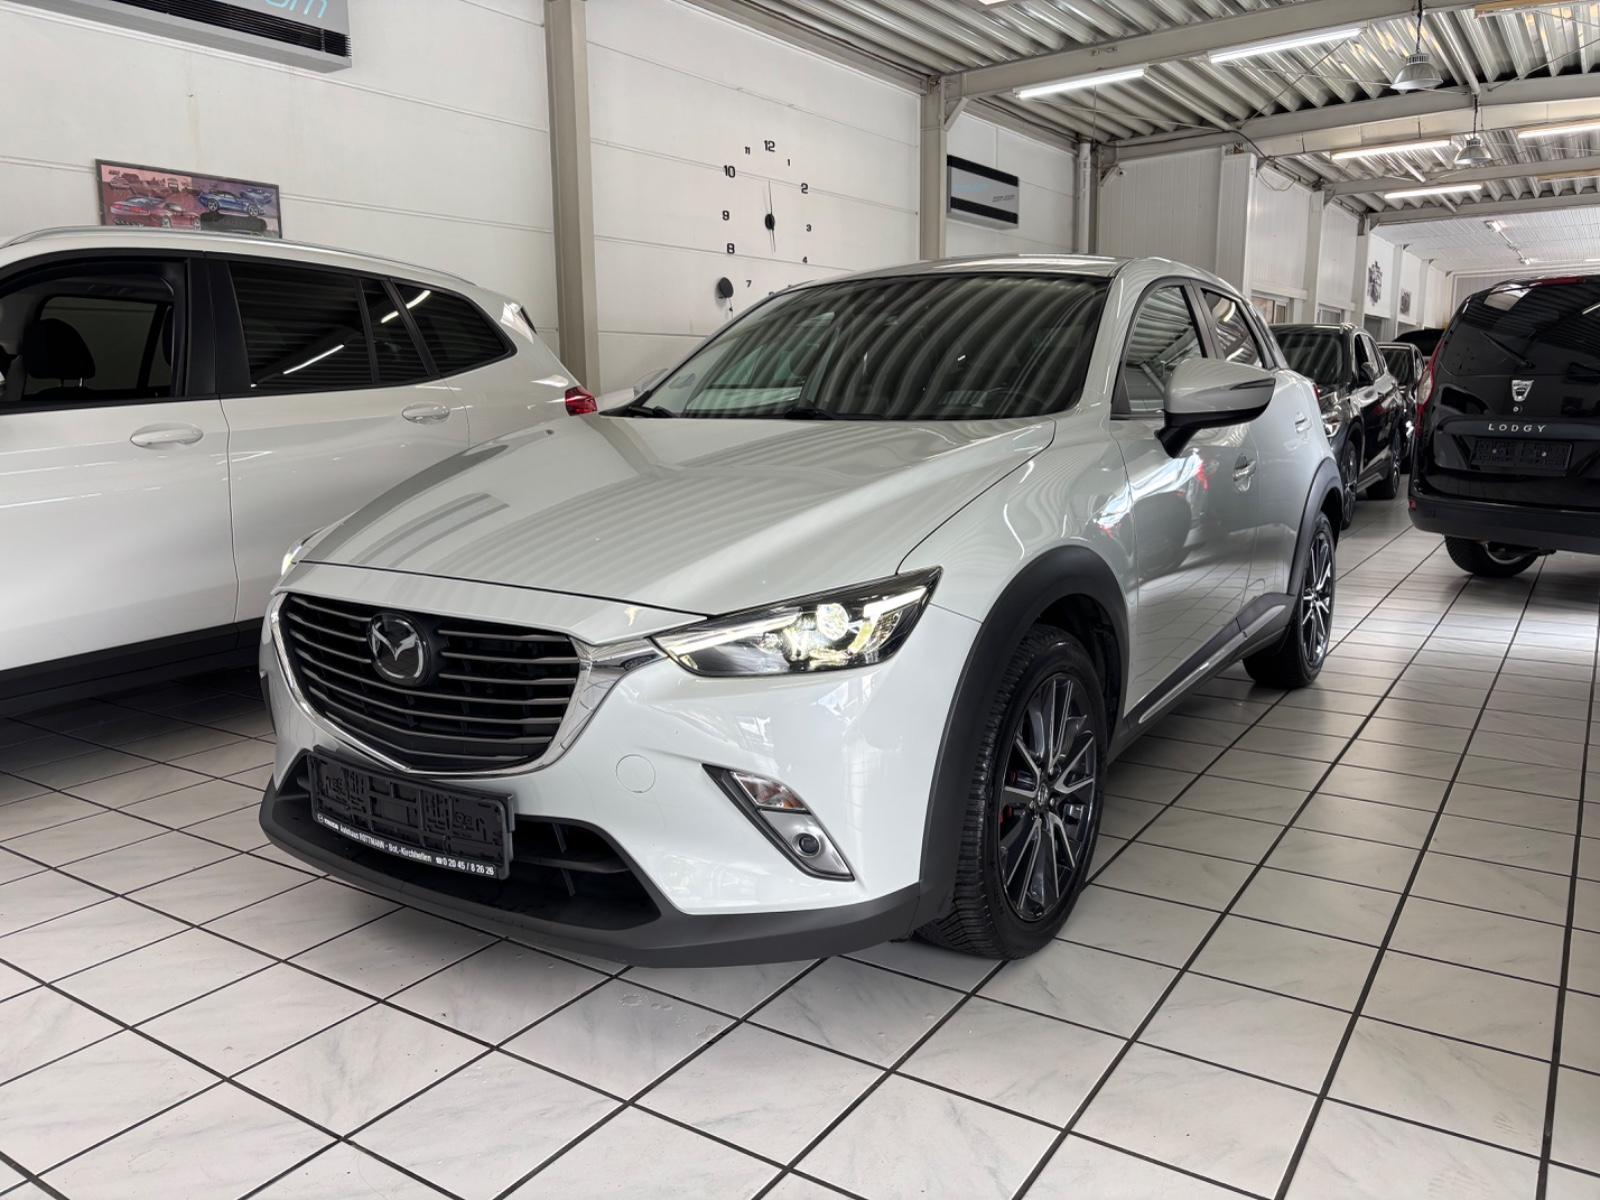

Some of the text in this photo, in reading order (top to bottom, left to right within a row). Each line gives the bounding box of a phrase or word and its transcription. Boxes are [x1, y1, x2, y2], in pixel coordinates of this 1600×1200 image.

[764, 140, 775, 152] 12
[723, 165, 735, 178] 10
[801, 182, 808, 194] 2
[722, 210, 730, 221] 9
[806, 224, 812, 232] 3
[727, 243, 736, 255] 8
[802, 256, 808, 264] 4
[746, 280, 752, 288] 7
[1488, 423, 1546, 432] LODGY
[448, 858, 457, 868] 20
